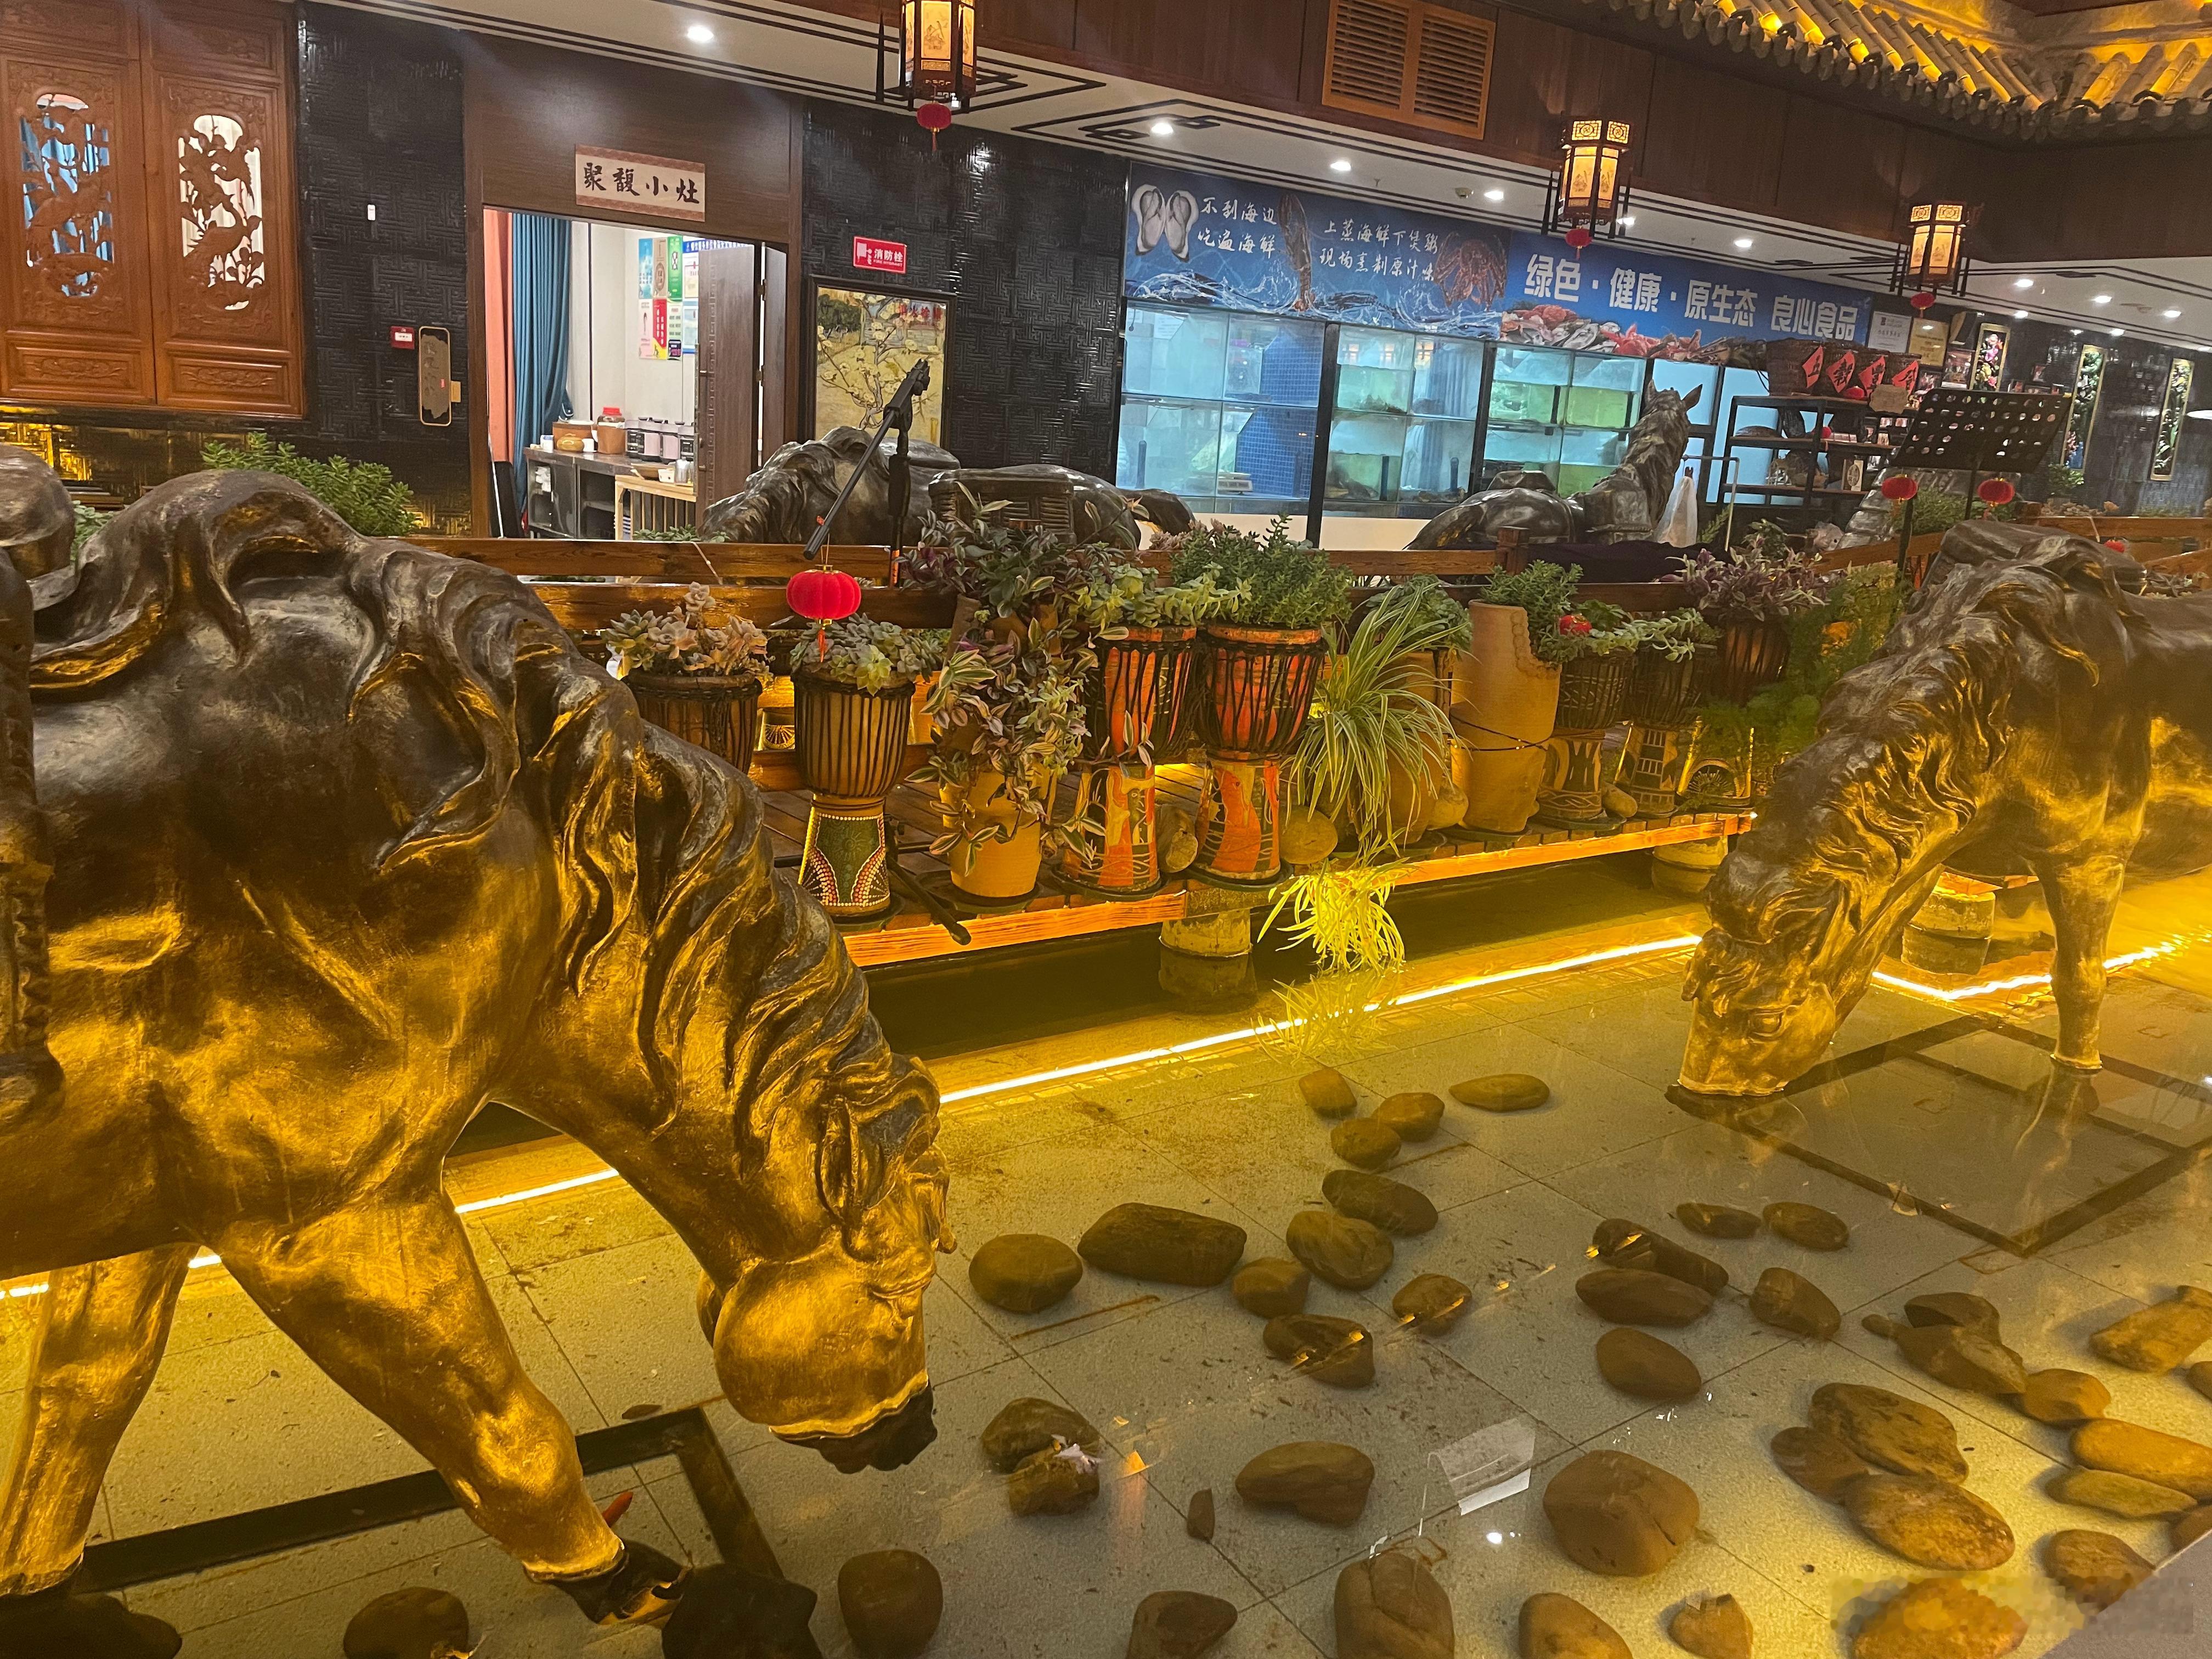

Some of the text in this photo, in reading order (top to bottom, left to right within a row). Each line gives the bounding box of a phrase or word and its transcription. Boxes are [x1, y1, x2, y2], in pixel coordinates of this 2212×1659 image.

[583, 162, 699, 204] 聚馥小灶
[1200, 197, 1277, 225] 不到海边
[1198, 227, 1276, 259] 吃遍海鲜
[1324, 218, 1439, 255] 上蒸海鲜下煲粥
[874, 249, 904, 263] 消防栓
[1770, 295, 1858, 341] 良心食品
